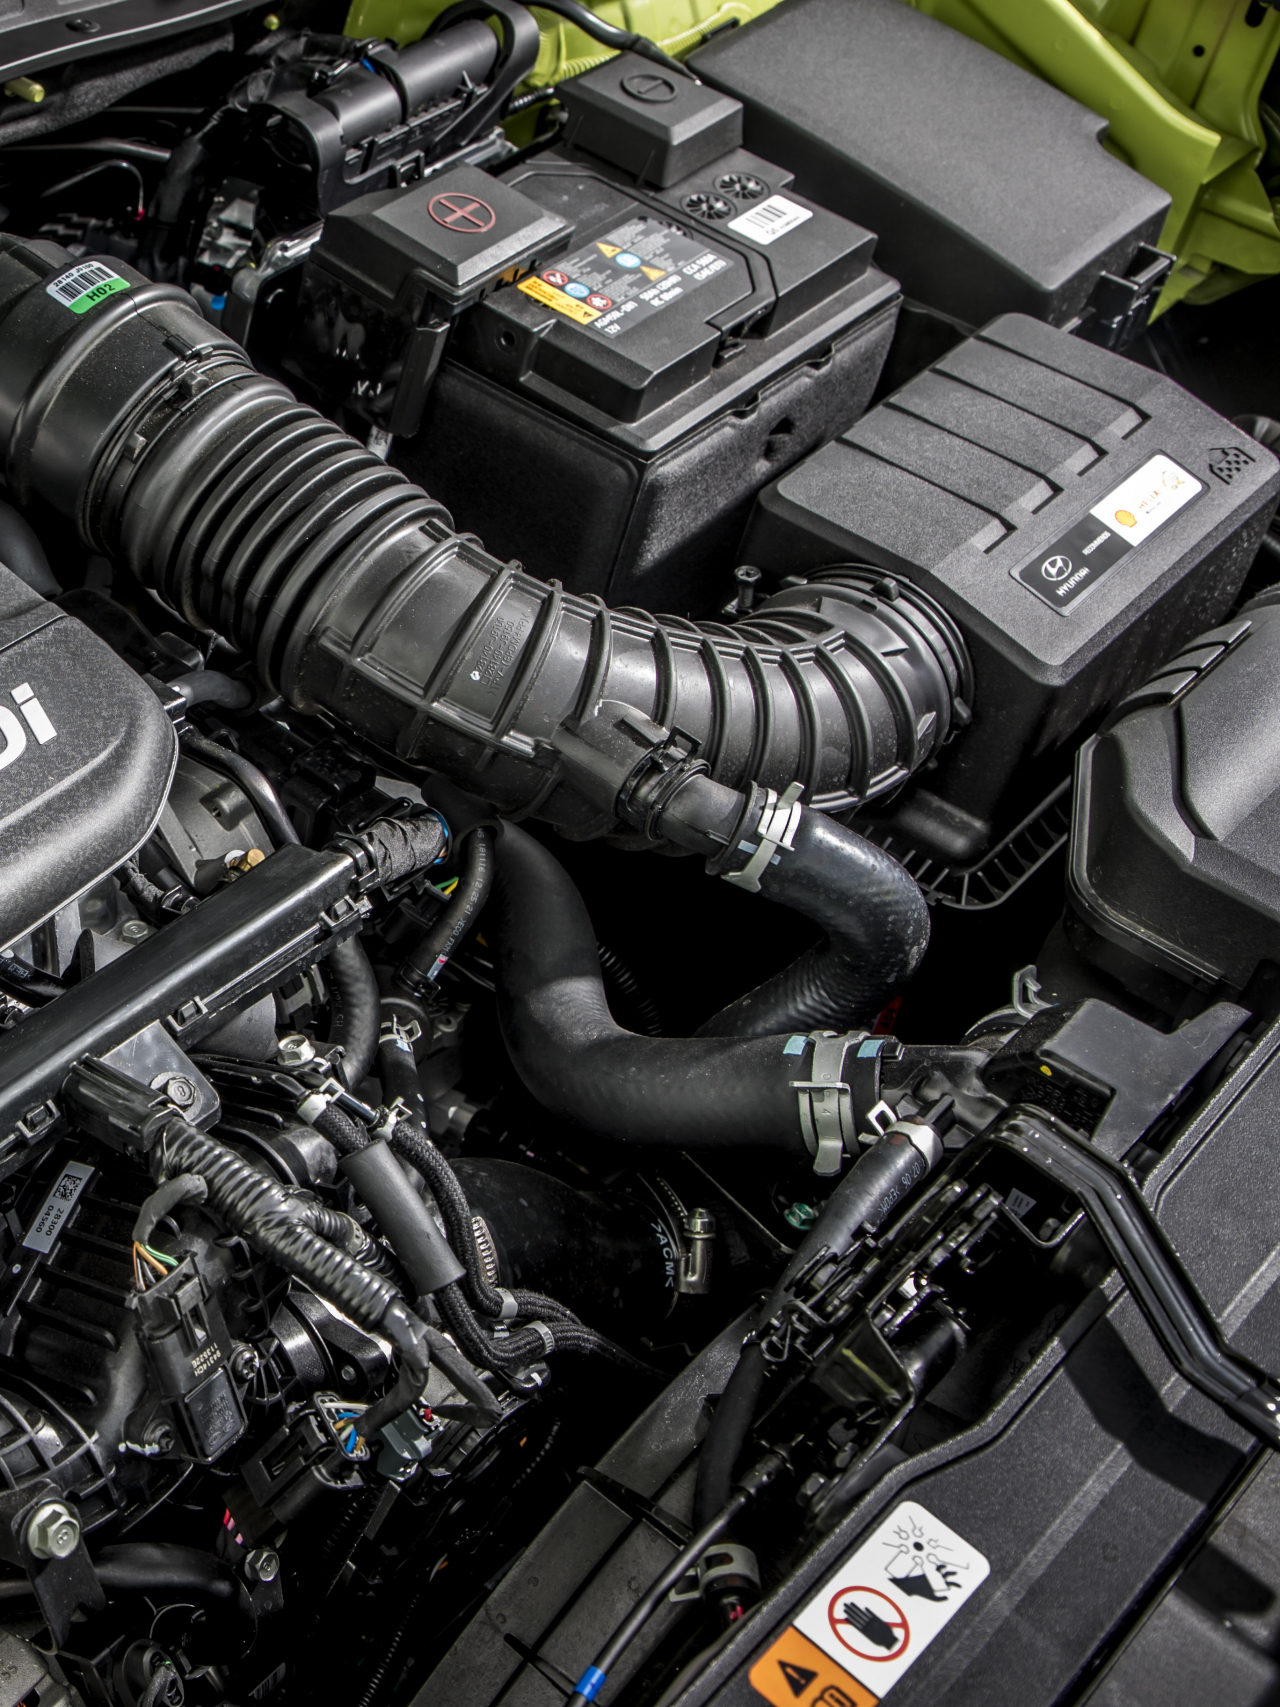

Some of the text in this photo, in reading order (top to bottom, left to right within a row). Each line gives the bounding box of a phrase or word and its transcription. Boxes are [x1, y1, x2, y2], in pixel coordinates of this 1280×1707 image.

[53, 272, 75, 288] 28140
[86, 283, 116, 302] H02
[1055, 567, 1091, 597] HYUNDAI
[45, 1207, 65, 1236] 28300
[191, 1342, 218, 1369] 113522E
[194, 1349, 222, 1377] 94314CH
